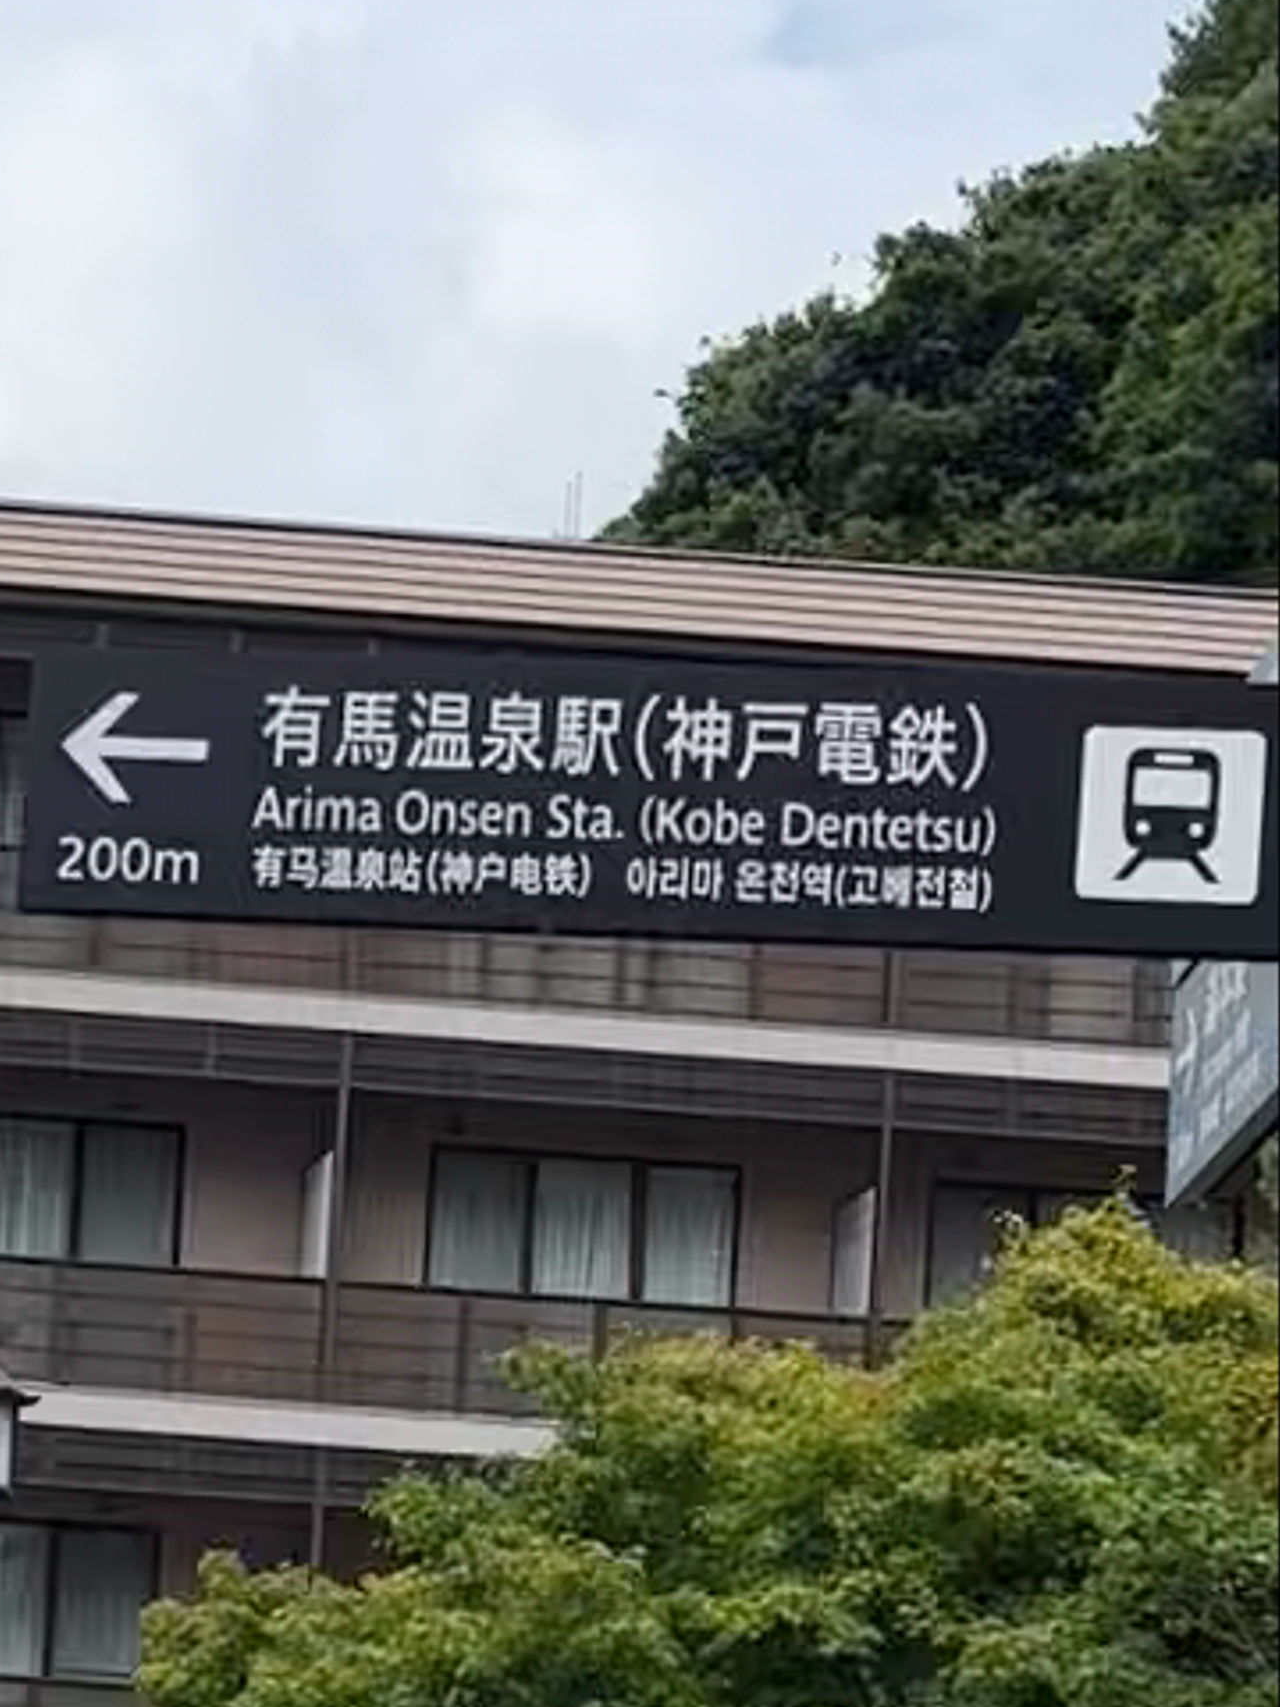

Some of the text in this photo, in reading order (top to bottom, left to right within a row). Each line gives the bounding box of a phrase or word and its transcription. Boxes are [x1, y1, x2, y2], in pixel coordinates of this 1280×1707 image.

[261, 685, 988, 791] 有馬温泉駅(神戸電鉄)
[252, 786, 996, 856] Arima Onsen Sta. (Kobe Dentetsu)
[57, 835, 200, 884] 200m
[626, 856, 724, 901] 아리마
